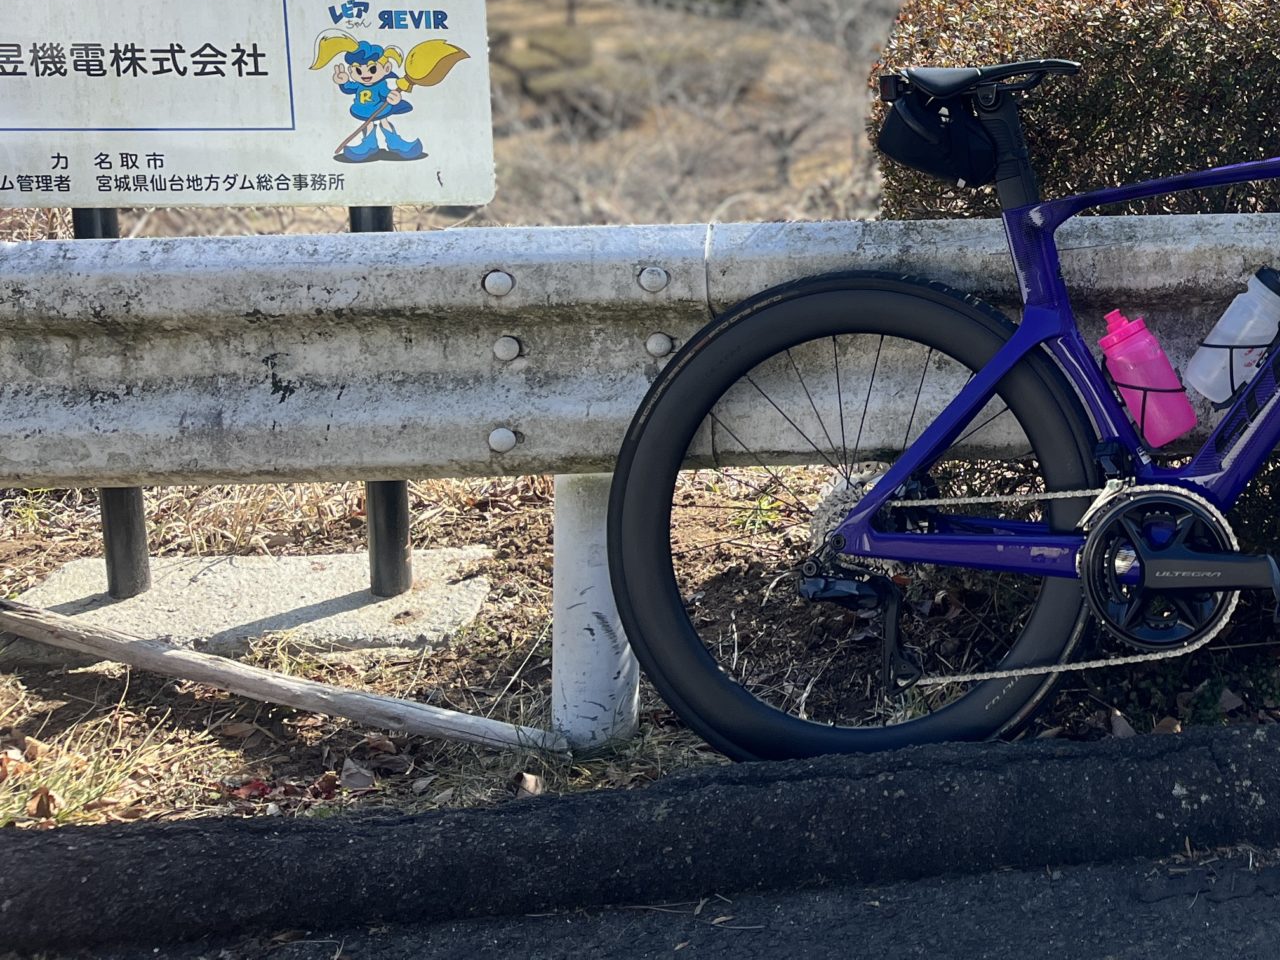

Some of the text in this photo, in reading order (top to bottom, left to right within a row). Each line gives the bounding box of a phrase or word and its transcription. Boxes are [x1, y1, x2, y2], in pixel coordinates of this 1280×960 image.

[94, 152, 165, 170] 名取市
[96, 173, 345, 192] 宮城県仙台地方ダム総合事務所
